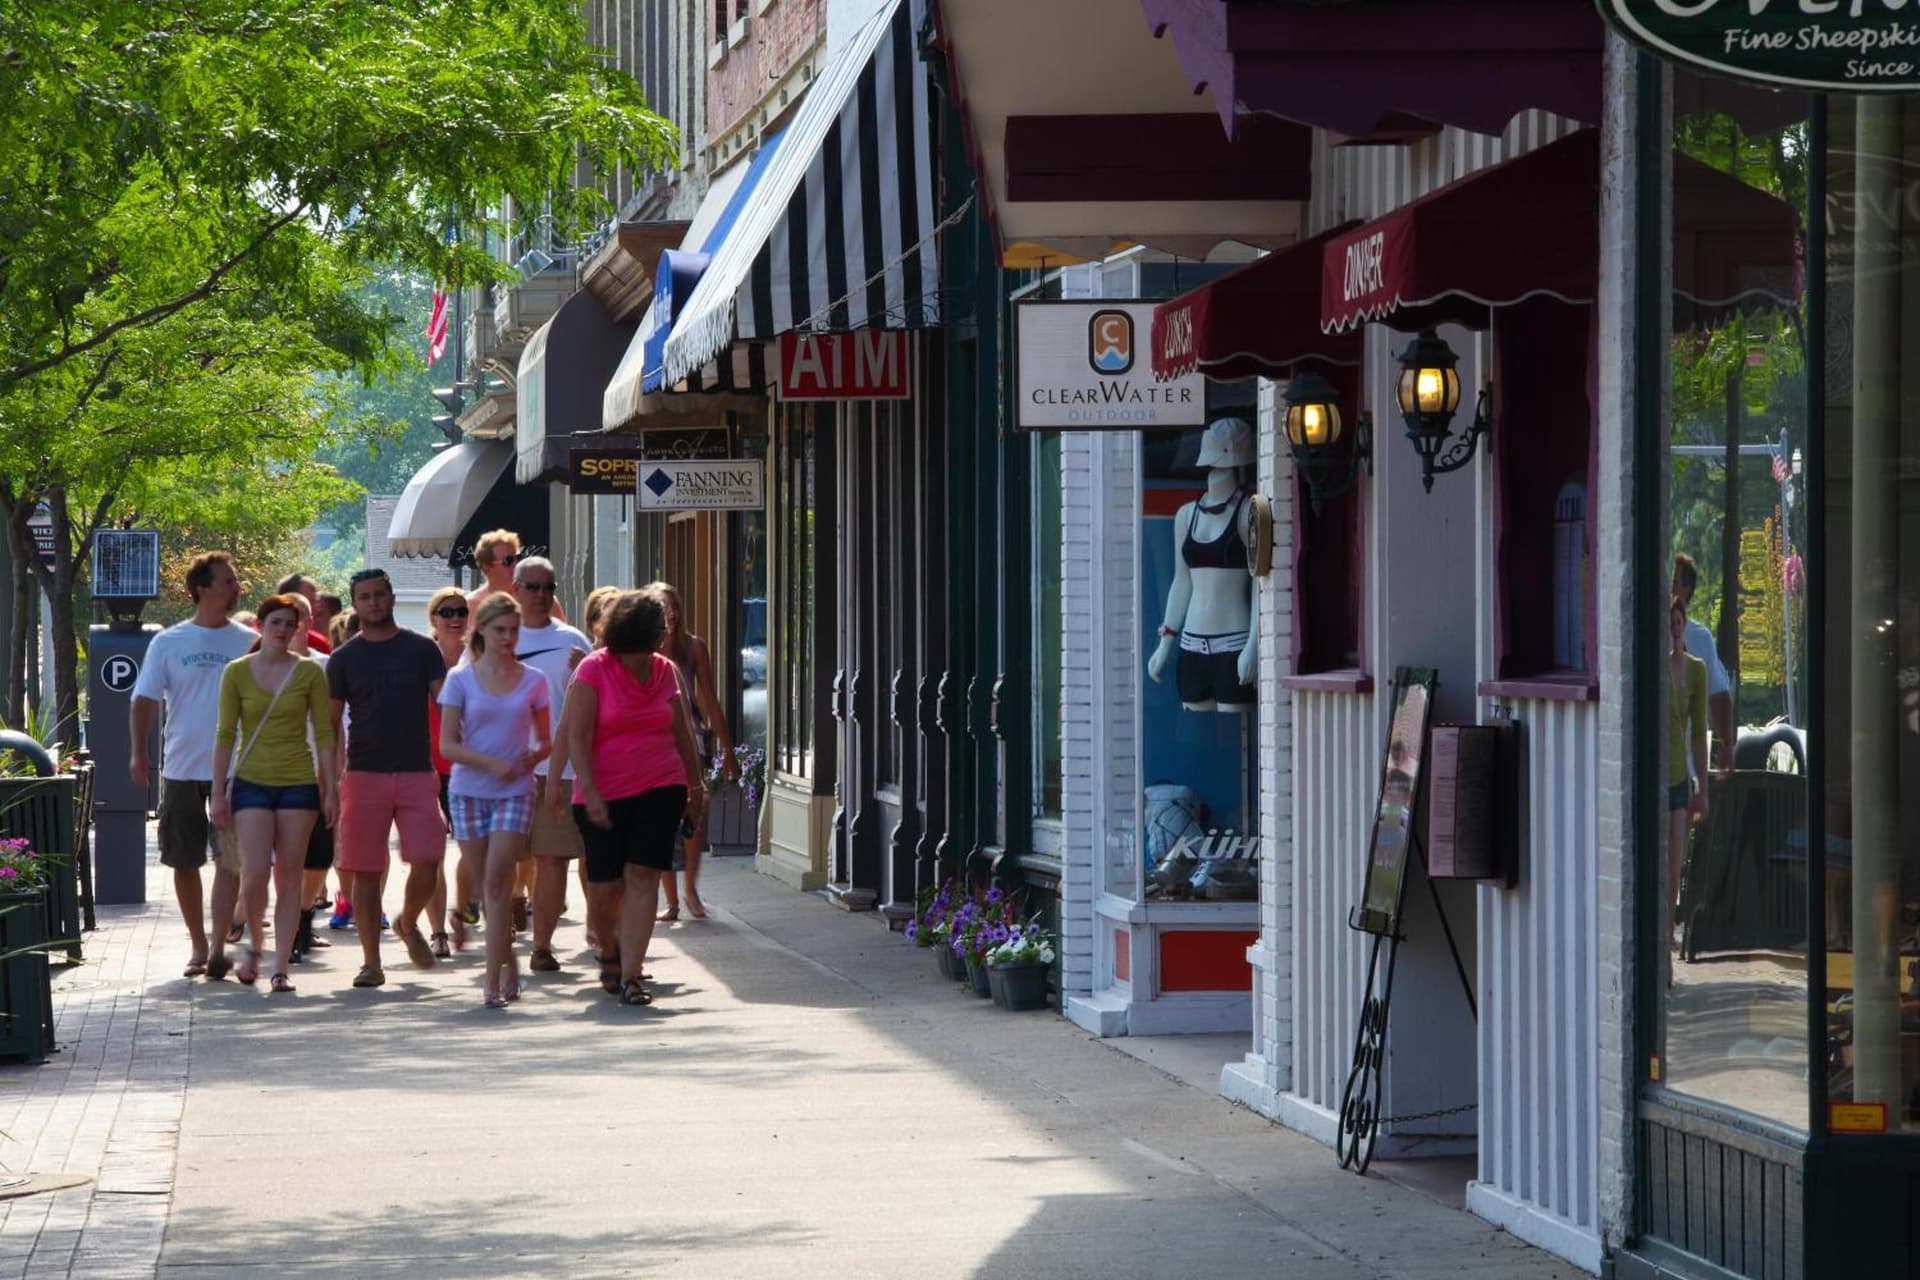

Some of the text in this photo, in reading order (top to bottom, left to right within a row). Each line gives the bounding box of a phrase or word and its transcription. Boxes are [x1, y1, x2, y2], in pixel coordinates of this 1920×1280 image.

[1724, 28, 1793, 53] Fine
[1844, 59, 1914, 78] Since
[1344, 231, 1384, 302] DINNER
[1164, 305, 1193, 360] LUNCH
[789, 330, 898, 389] ATM
[1032, 381, 1192, 404] CLEARWATER
[1068, 409, 1157, 422] OUTDOOR
[580, 458, 637, 476] SOPR
[675, 470, 753, 488] FANNING
[675, 488, 728, 497] INVESTMENT
[112, 661, 131, 686] P
[1172, 828, 1259, 860] KÜH
